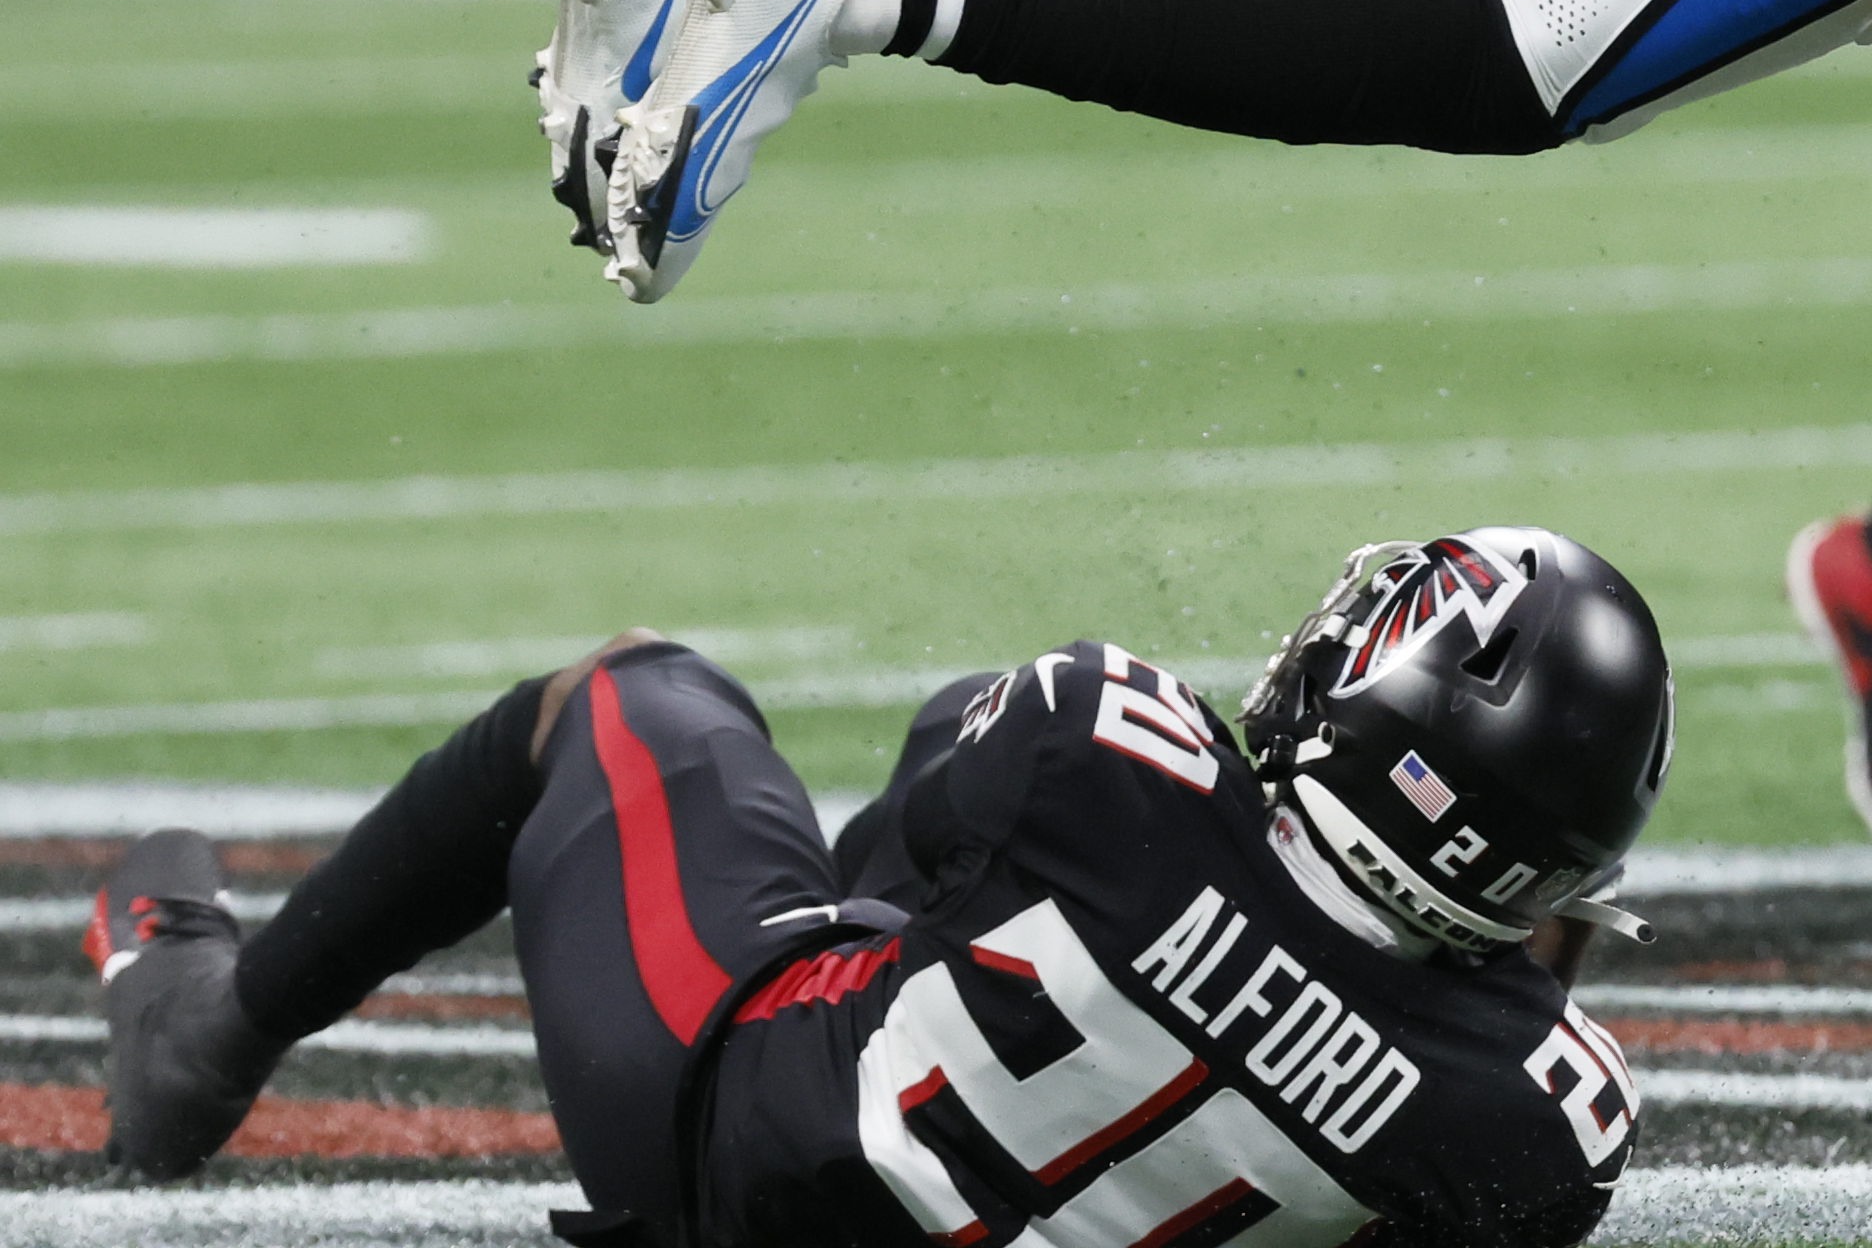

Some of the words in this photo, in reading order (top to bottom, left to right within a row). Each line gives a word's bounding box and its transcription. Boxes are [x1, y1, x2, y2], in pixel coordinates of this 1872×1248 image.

[1346, 838, 1500, 954] FALCON
[1429, 825, 1538, 904] 20
[1131, 885, 1421, 1154] ALFORD
